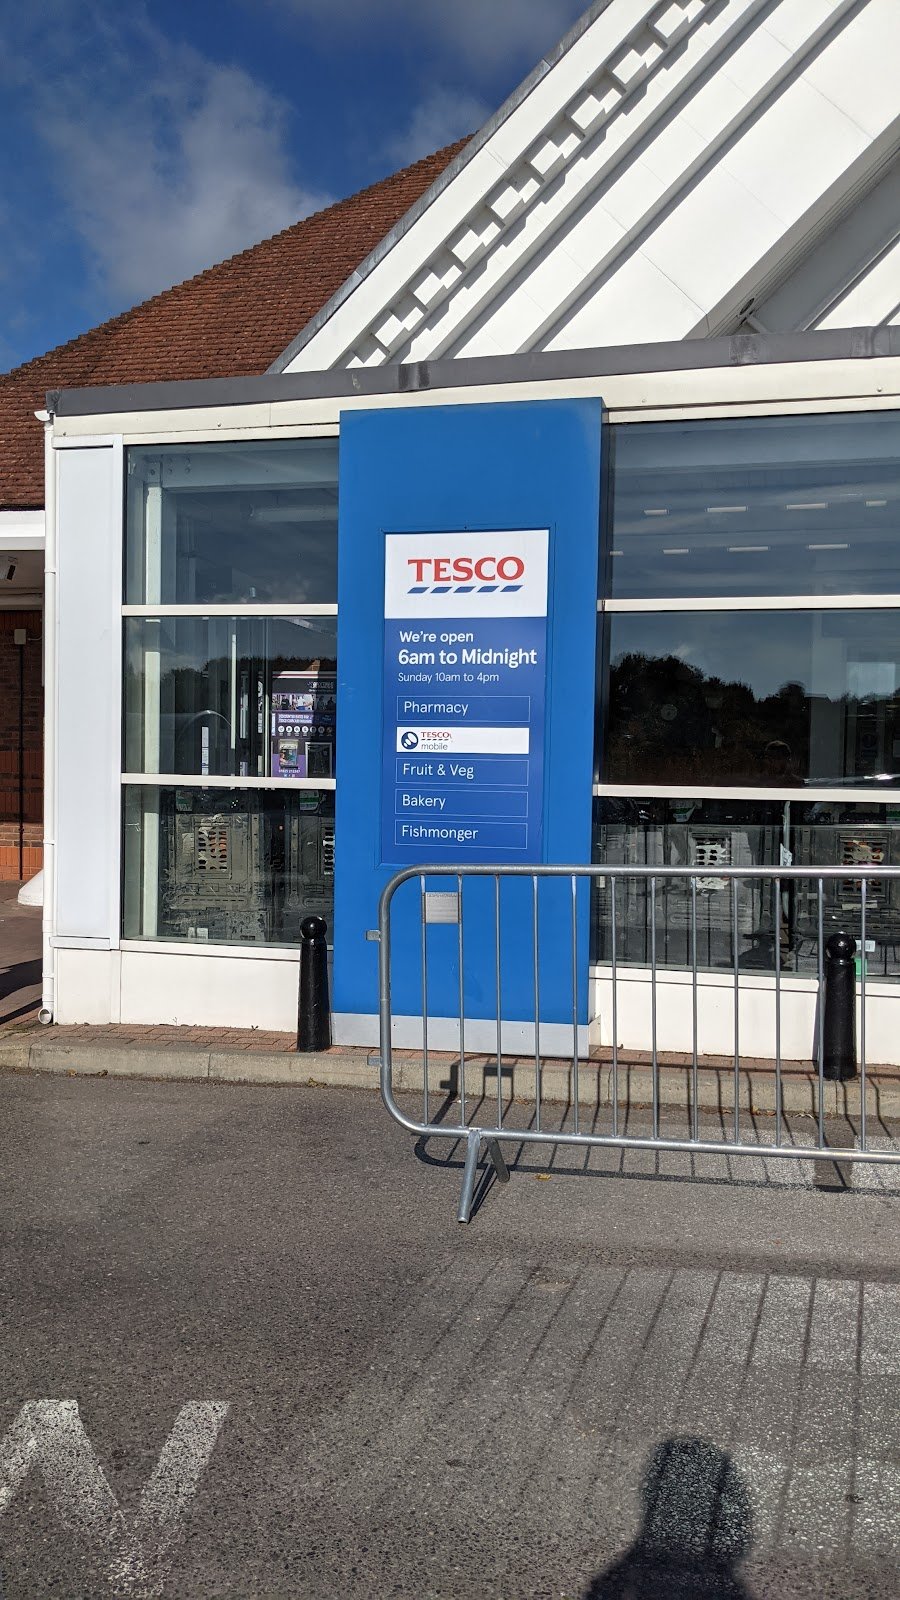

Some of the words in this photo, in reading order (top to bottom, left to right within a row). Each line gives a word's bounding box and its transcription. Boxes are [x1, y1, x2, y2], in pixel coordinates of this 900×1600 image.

[408, 556, 525, 582] TESCO
[440, 632, 474, 645] open
[398, 649, 435, 665] 6am
[439, 651, 458, 665] to
[461, 648, 537, 668] Midnight
[398, 672, 432, 684] Sunday
[435, 673, 460, 682] 10am
[463, 673, 474, 682] to
[477, 673, 500, 684] 4pm
[404, 701, 469, 716] Pharmacy
[421, 731, 450, 739] TESCO
[421, 743, 448, 751] mobile
[403, 763, 433, 776] Fruit
[437, 764, 446, 776] &
[450, 764, 474, 780] Veg
[402, 794, 446, 810] Bakery
[402, 825, 478, 842] Fishmonger
